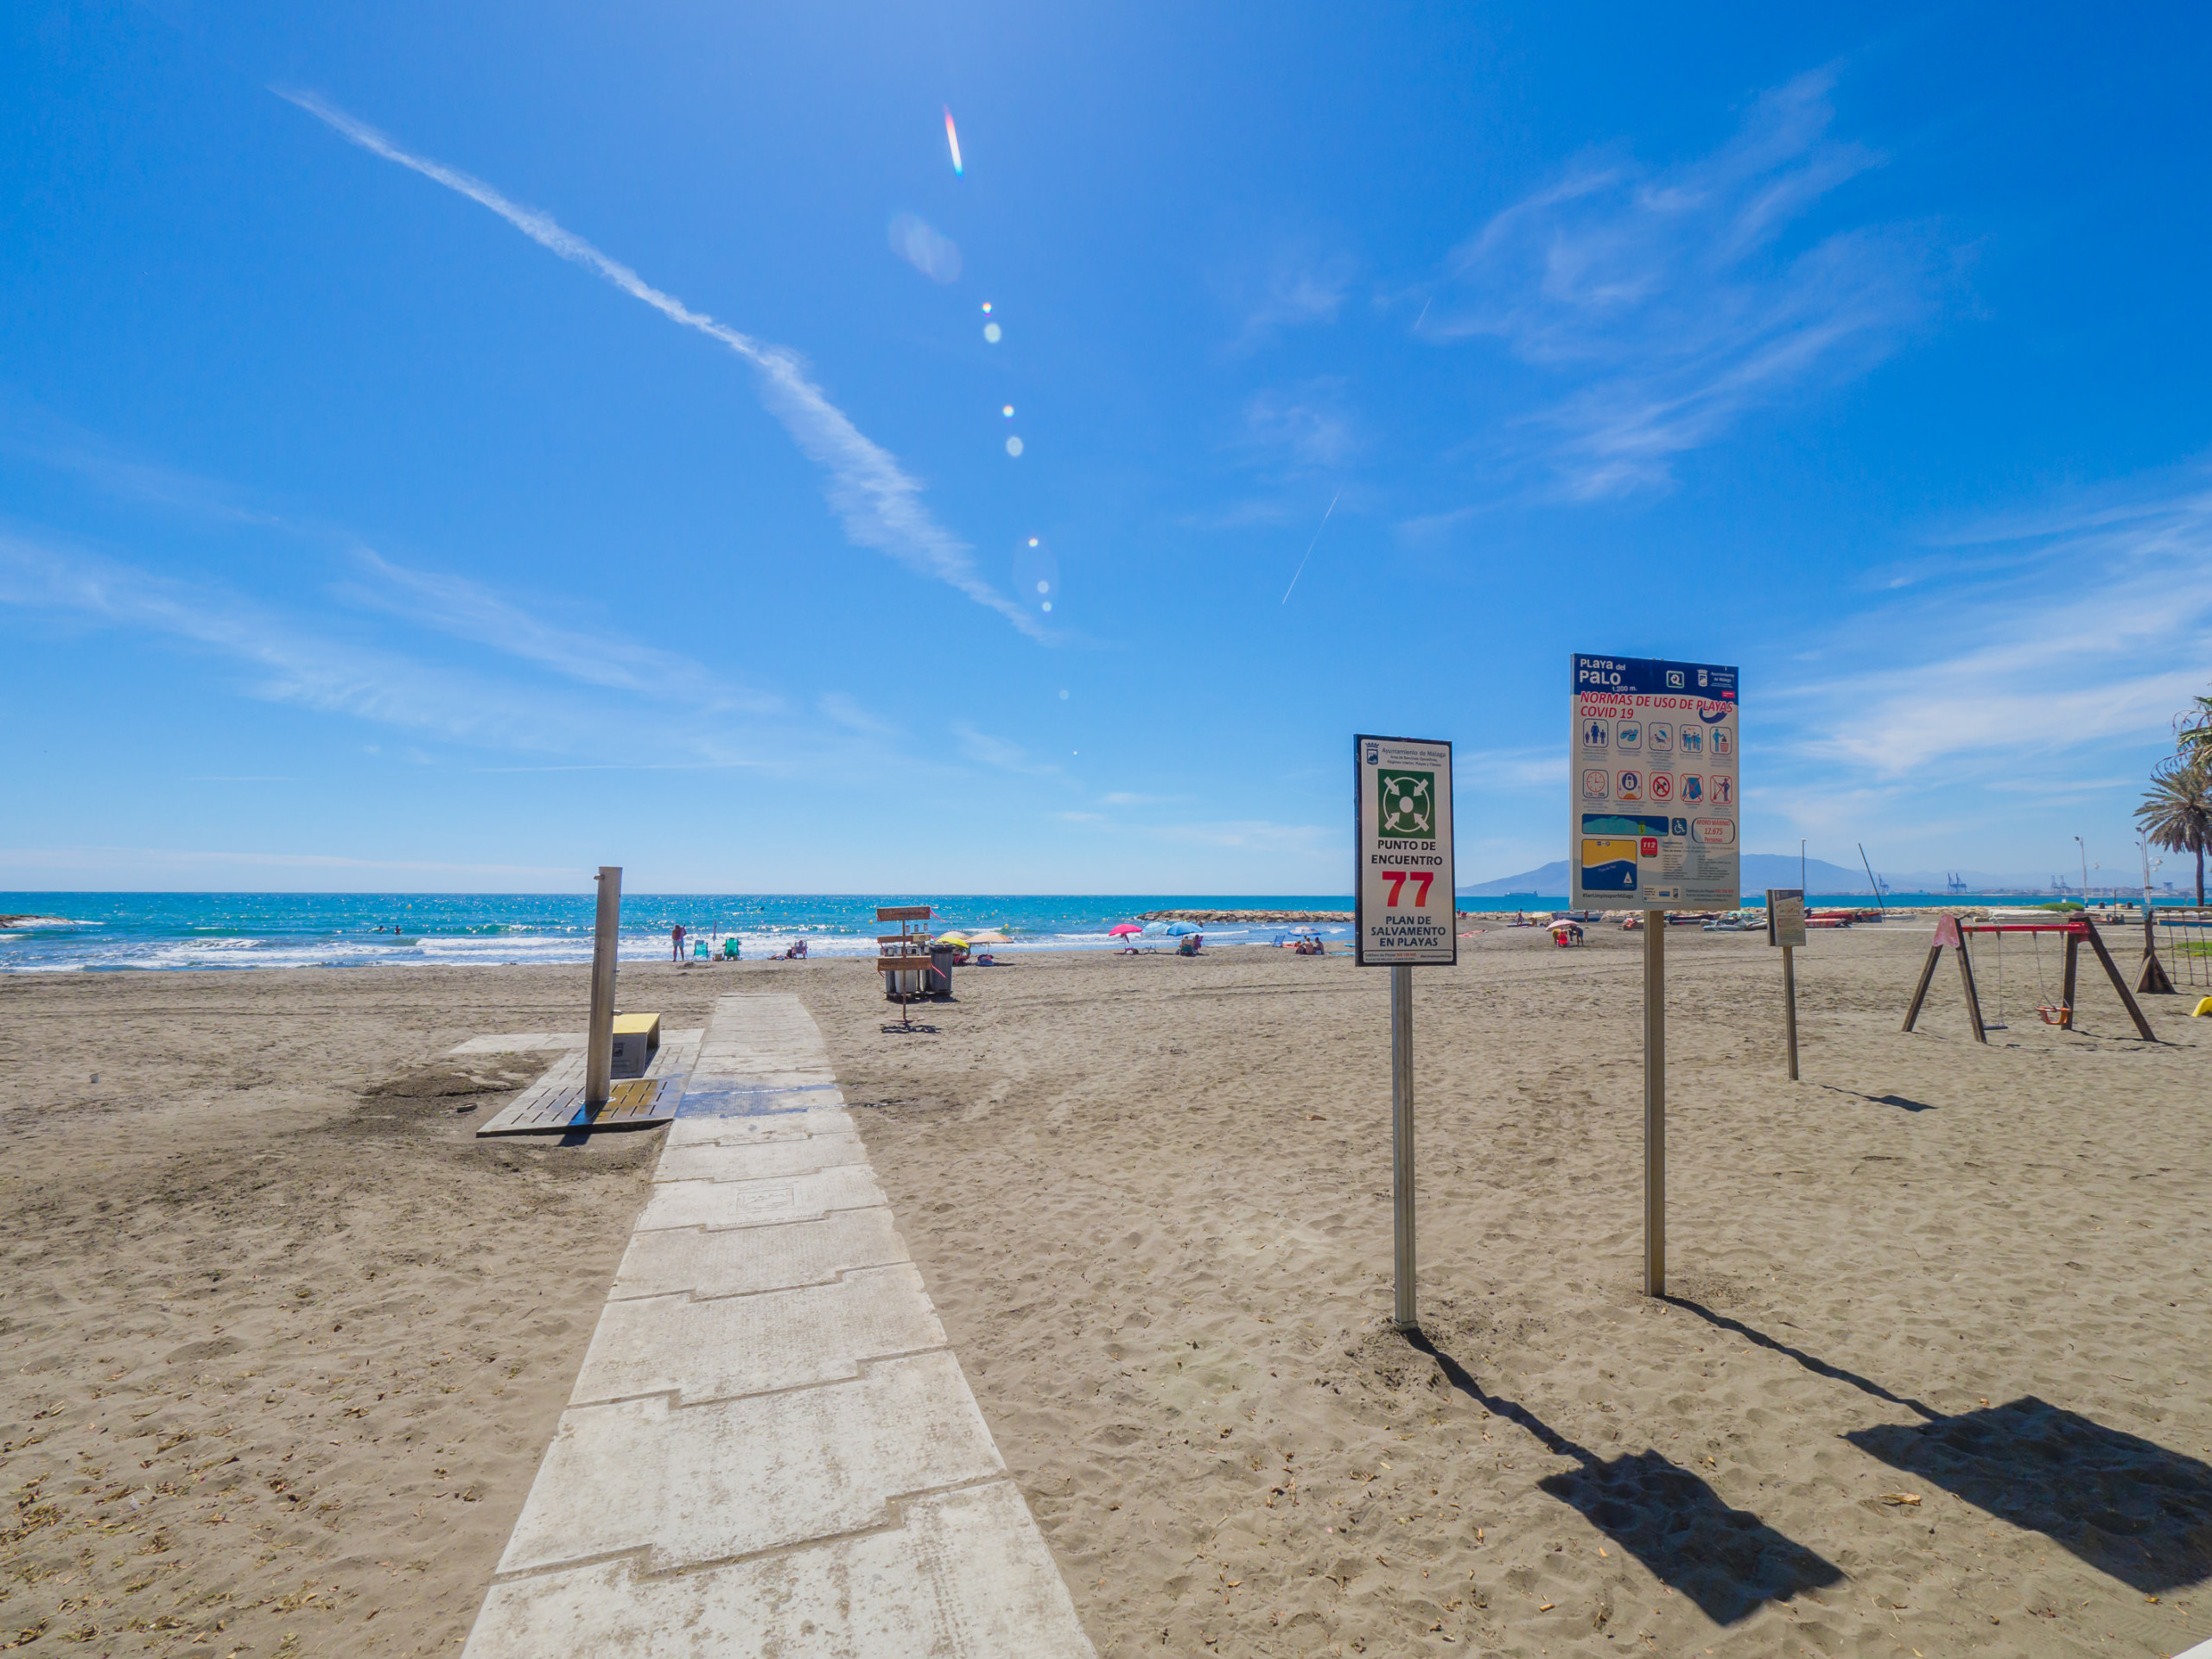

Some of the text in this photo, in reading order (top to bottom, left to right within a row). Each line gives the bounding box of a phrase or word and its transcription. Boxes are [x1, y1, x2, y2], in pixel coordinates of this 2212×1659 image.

[1580, 690, 1733, 713] NORMAS DE USO DE PLAYAS
[1580, 705, 1634, 719] COVID 19
[1377, 839, 1436, 850] PUNTO DE
[1371, 855, 1443, 866] ENCUENTRO
[1382, 871, 1434, 907] 77
[1385, 916, 1432, 925] PLAN DE
[1370, 926, 1446, 936] SALVAMENTO
[1379, 938, 1439, 947] EN PLAYAS
